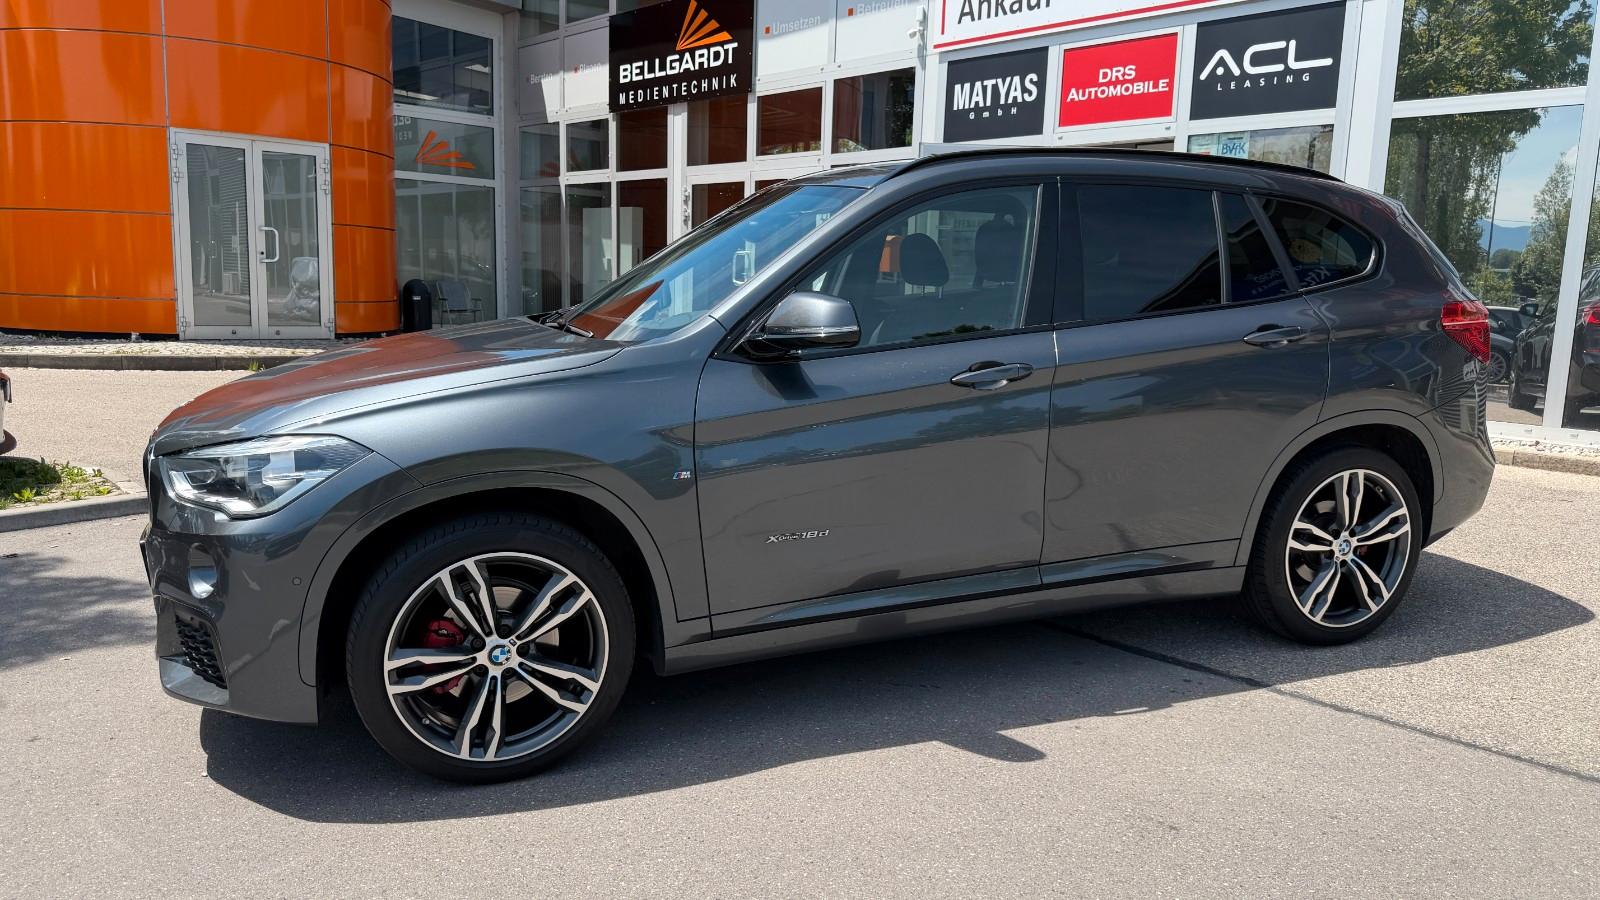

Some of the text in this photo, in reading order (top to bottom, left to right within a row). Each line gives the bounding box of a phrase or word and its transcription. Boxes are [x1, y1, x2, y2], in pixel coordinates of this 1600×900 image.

[957, 0, 1050, 24] Ankau
[773, 15, 821, 34] Umsetzen
[619, 43, 738, 84] BELLGARDT
[1200, 39, 1333, 81] ACL
[1098, 65, 1136, 84] DRS
[1217, 72, 1310, 91] LEASING
[619, 73, 738, 105] MEDIENTECHNIK
[953, 73, 1038, 111] MATYAS
[1067, 79, 1169, 102] AUTOMOBILE
